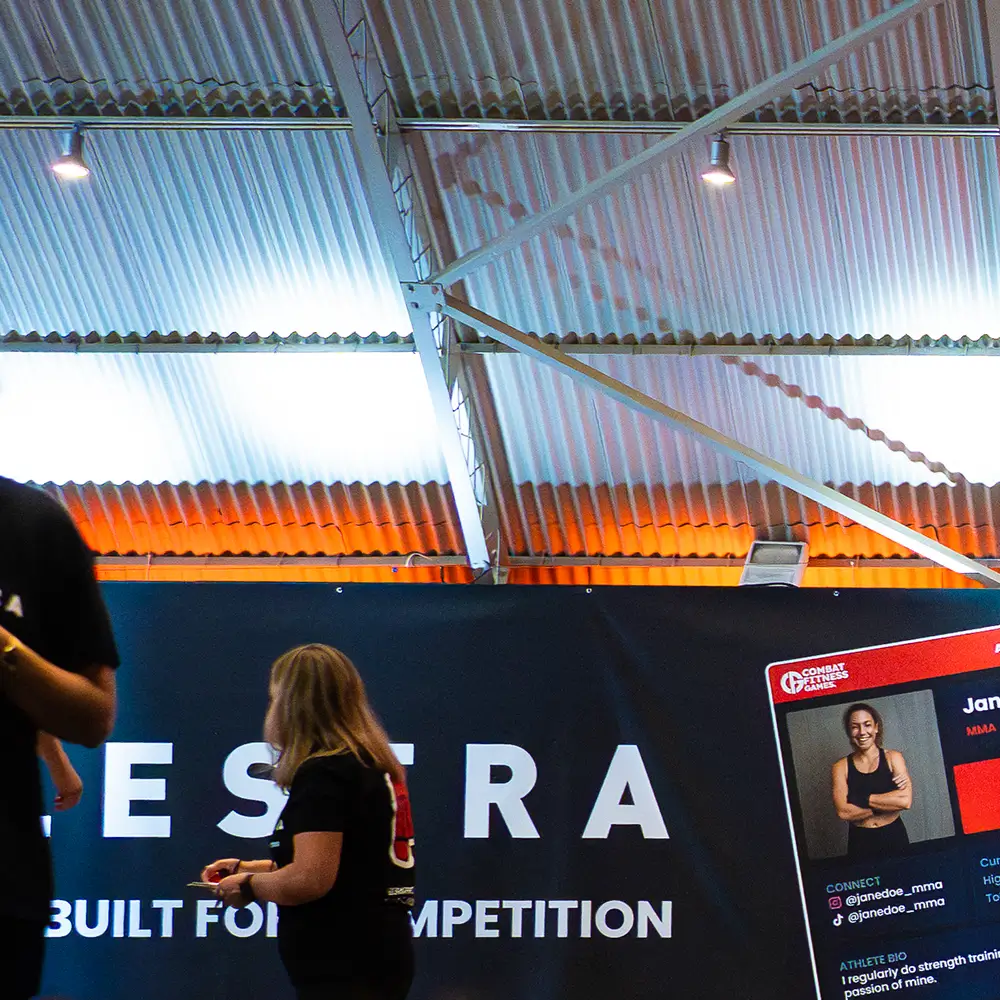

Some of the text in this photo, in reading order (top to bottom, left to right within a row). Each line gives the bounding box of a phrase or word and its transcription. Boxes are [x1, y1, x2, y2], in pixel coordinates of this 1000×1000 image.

[802, 663, 845, 676] COMBAT
[803, 671, 849, 684] FITNESS
[966, 723, 996, 736] MMA
[826, 876, 880, 893] CONNECT
[846, 881, 943, 906] @janedoe_mma
[44, 899, 184, 938] BUILT
[408, 899, 673, 938] MPETITION
[848, 898, 945, 923] @janedoe_mma
[840, 951, 907, 971] ATHLETE BIO
[841, 976, 846, 985] I
[848, 968, 898, 985] regularly
[901, 965, 916, 975] do
[918, 955, 966, 972] strength
[844, 975, 937, 1000] passion of mine.
